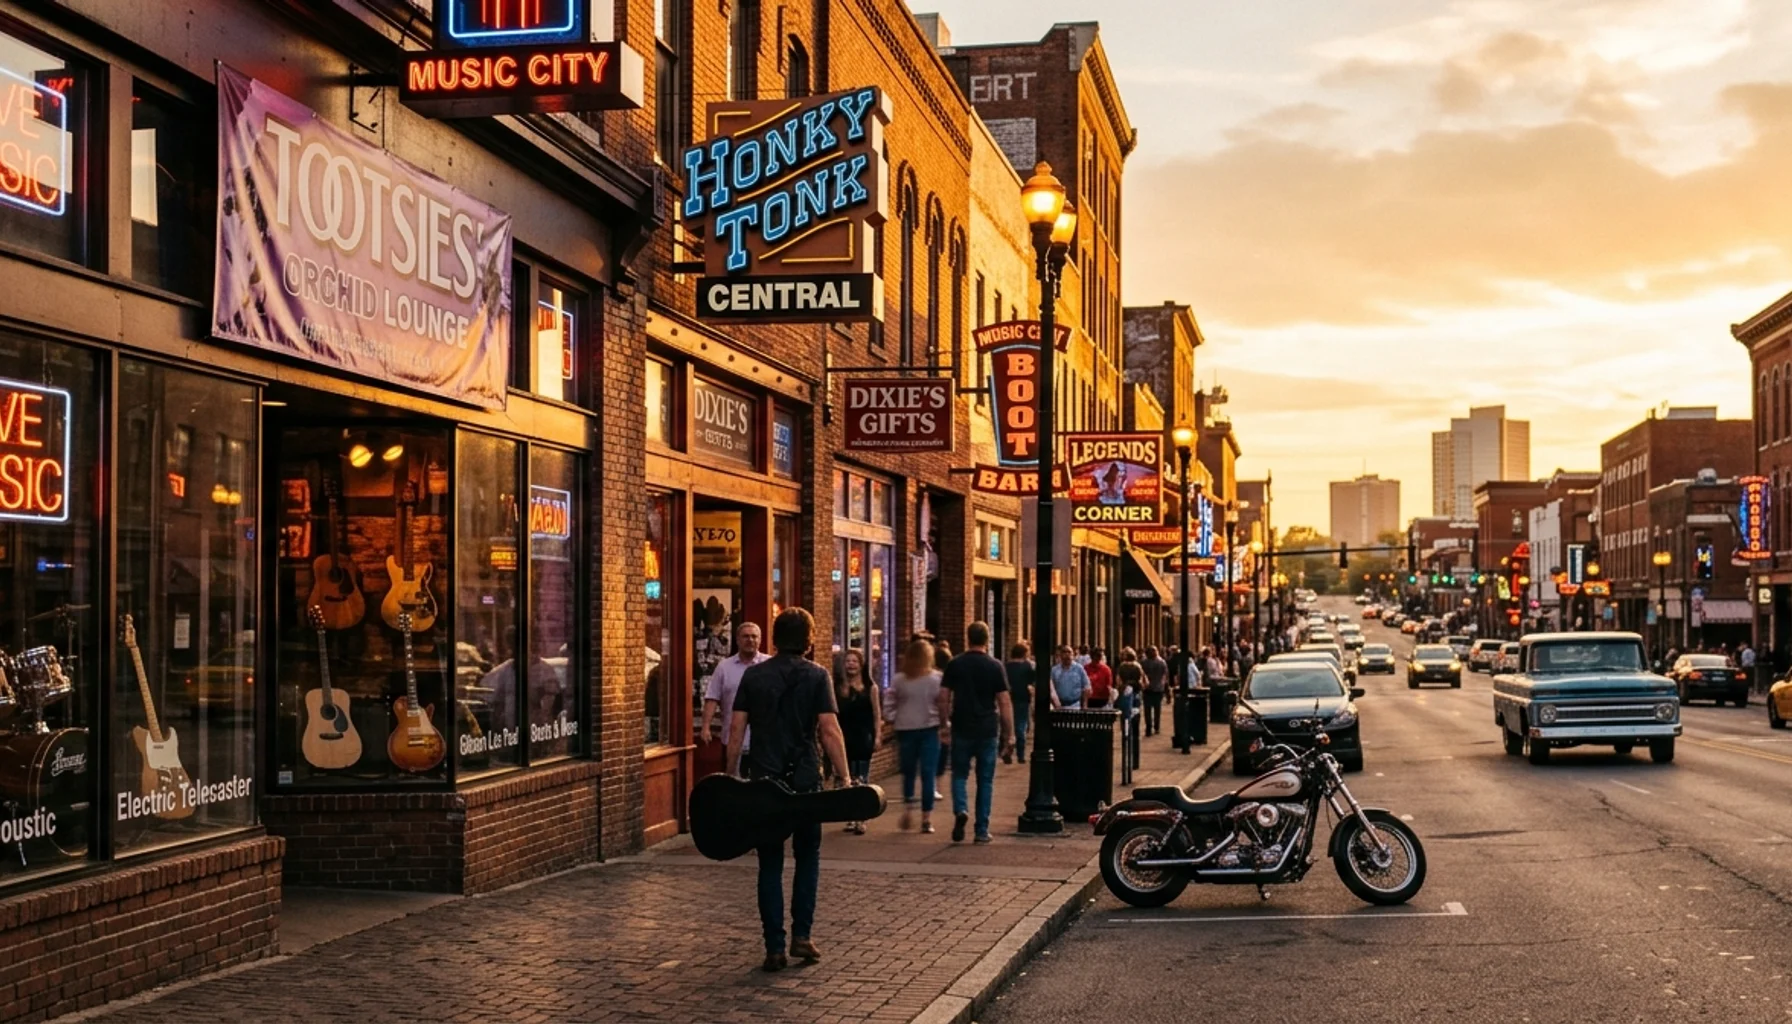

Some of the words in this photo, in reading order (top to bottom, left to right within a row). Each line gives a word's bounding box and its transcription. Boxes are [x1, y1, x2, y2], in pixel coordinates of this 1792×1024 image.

[409, 57, 518, 90] MUSIC
[528, 51, 609, 85] CITY
[685, 89, 874, 216] HONKY
[716, 154, 867, 271] TONK
[283, 252, 379, 321] ORCHID
[384, 289, 470, 349] LOUNGE
[708, 281, 860, 312] CENTRAL
[978, 324, 1024, 346] MUSIC
[694, 387, 748, 434] DIXIE'S
[850, 386, 946, 409] DIXIE'S
[1006, 353, 1036, 456] BOOT
[859, 412, 936, 434] GIFTS
[1071, 441, 1156, 467] LEGENDS
[1074, 506, 1153, 521] CORNER
[117, 785, 176, 821] Electric
